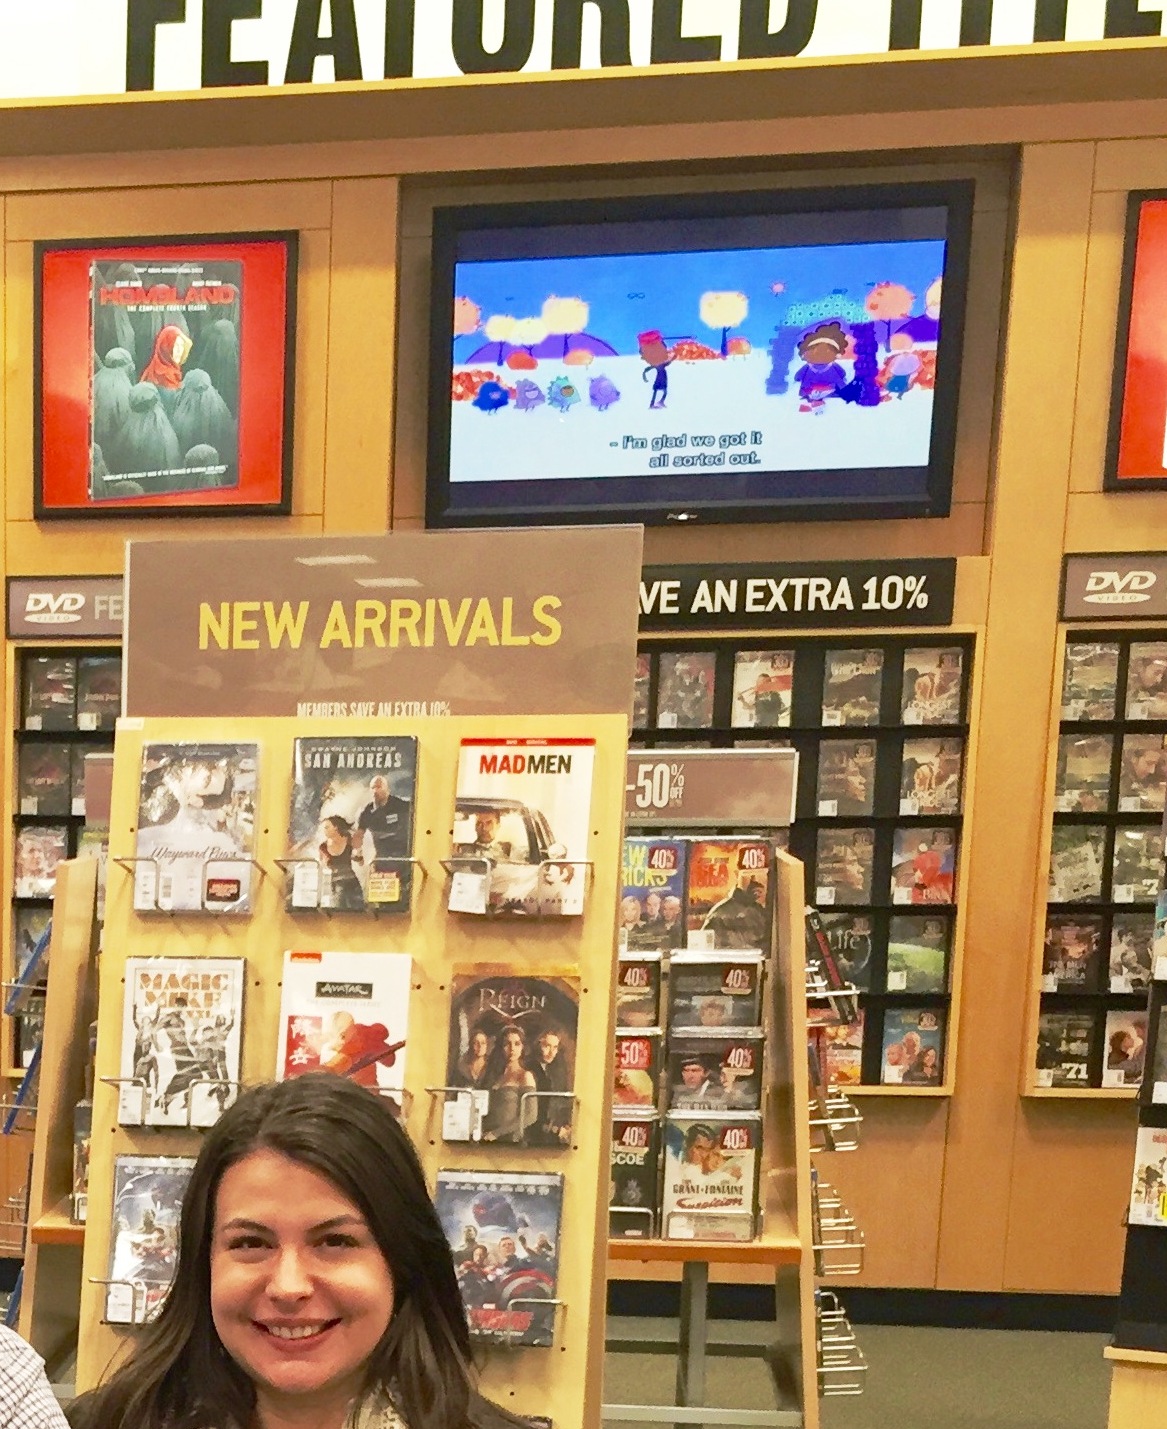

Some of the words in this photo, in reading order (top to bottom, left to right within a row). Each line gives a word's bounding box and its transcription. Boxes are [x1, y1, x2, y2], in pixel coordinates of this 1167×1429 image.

[100, 285, 235, 306] HOMELAND
[622, 435, 648, 449] I'm
[651, 433, 687, 451] glad
[691, 435, 716, 447] we
[719, 432, 747, 449] got
[750, 431, 763, 445] it
[649, 453, 669, 468] all
[672, 452, 725, 467] sorted
[729, 451, 761, 465] out.
[1086, 570, 1157, 592] DVD
[25, 593, 85, 614] DVD
[691, 580, 738, 614] AN
[745, 577, 853, 612] EXTRA
[863, 575, 928, 611] 10%
[199, 601, 310, 650] NEW
[320, 595, 562, 650] ARRIVALS
[297, 702, 347, 717] MEMBERS
[349, 702, 376, 716] SAVE
[378, 702, 392, 716] AN
[394, 702, 426, 716] EXTRA
[305, 753, 331, 768] SAN
[337, 752, 402, 768] ANDREAS
[651, 849, 675, 868] 40%
[742, 849, 766, 868] 40%
[139, 973, 229, 991] MAGIC
[623, 967, 648, 987] 40%
[725, 968, 750, 988] 40%
[479, 988, 547, 1011] REIGN
[620, 1043, 648, 1065] 50%
[727, 1047, 753, 1068] 40%
[622, 1126, 647, 1146] 40%
[723, 1129, 749, 1149] 40%
